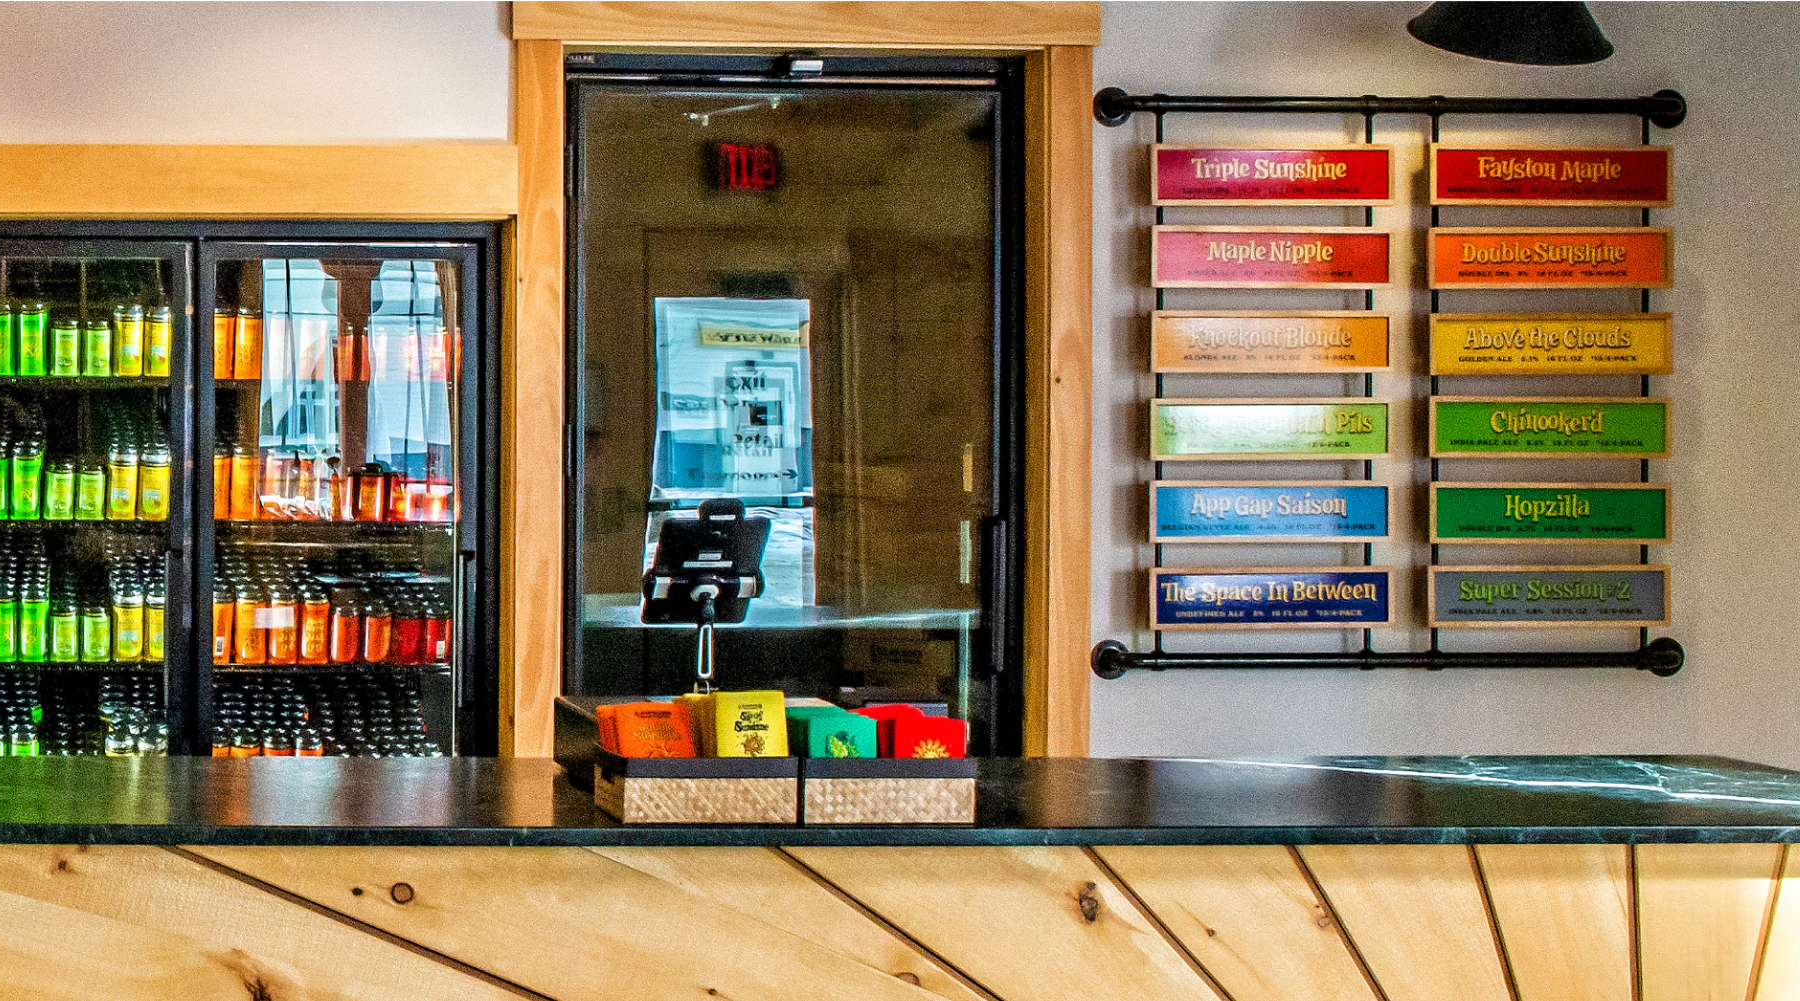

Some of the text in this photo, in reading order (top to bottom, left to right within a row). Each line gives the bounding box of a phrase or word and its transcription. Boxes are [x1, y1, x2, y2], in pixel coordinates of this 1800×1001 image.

[1191, 156, 1347, 181] Triple Sunshine
[1478, 156, 1622, 183] Fayston Maple
[1207, 240, 1333, 264] Maple Nipple
[1462, 241, 1627, 266] Double Sunshine
[1189, 325, 1352, 349] Knockout Blonde
[1464, 326, 1631, 351] Above the Clouds
[1334, 411, 1373, 435] Pils
[1491, 408, 1605, 436] Chinooker'd
[1191, 492, 1347, 518] App Gap Saison
[1505, 494, 1590, 522] Hopzilla
[1161, 581, 1378, 606] The Space In Between
[1460, 581, 1522, 604] Super
[1527, 577, 1605, 602] Session
